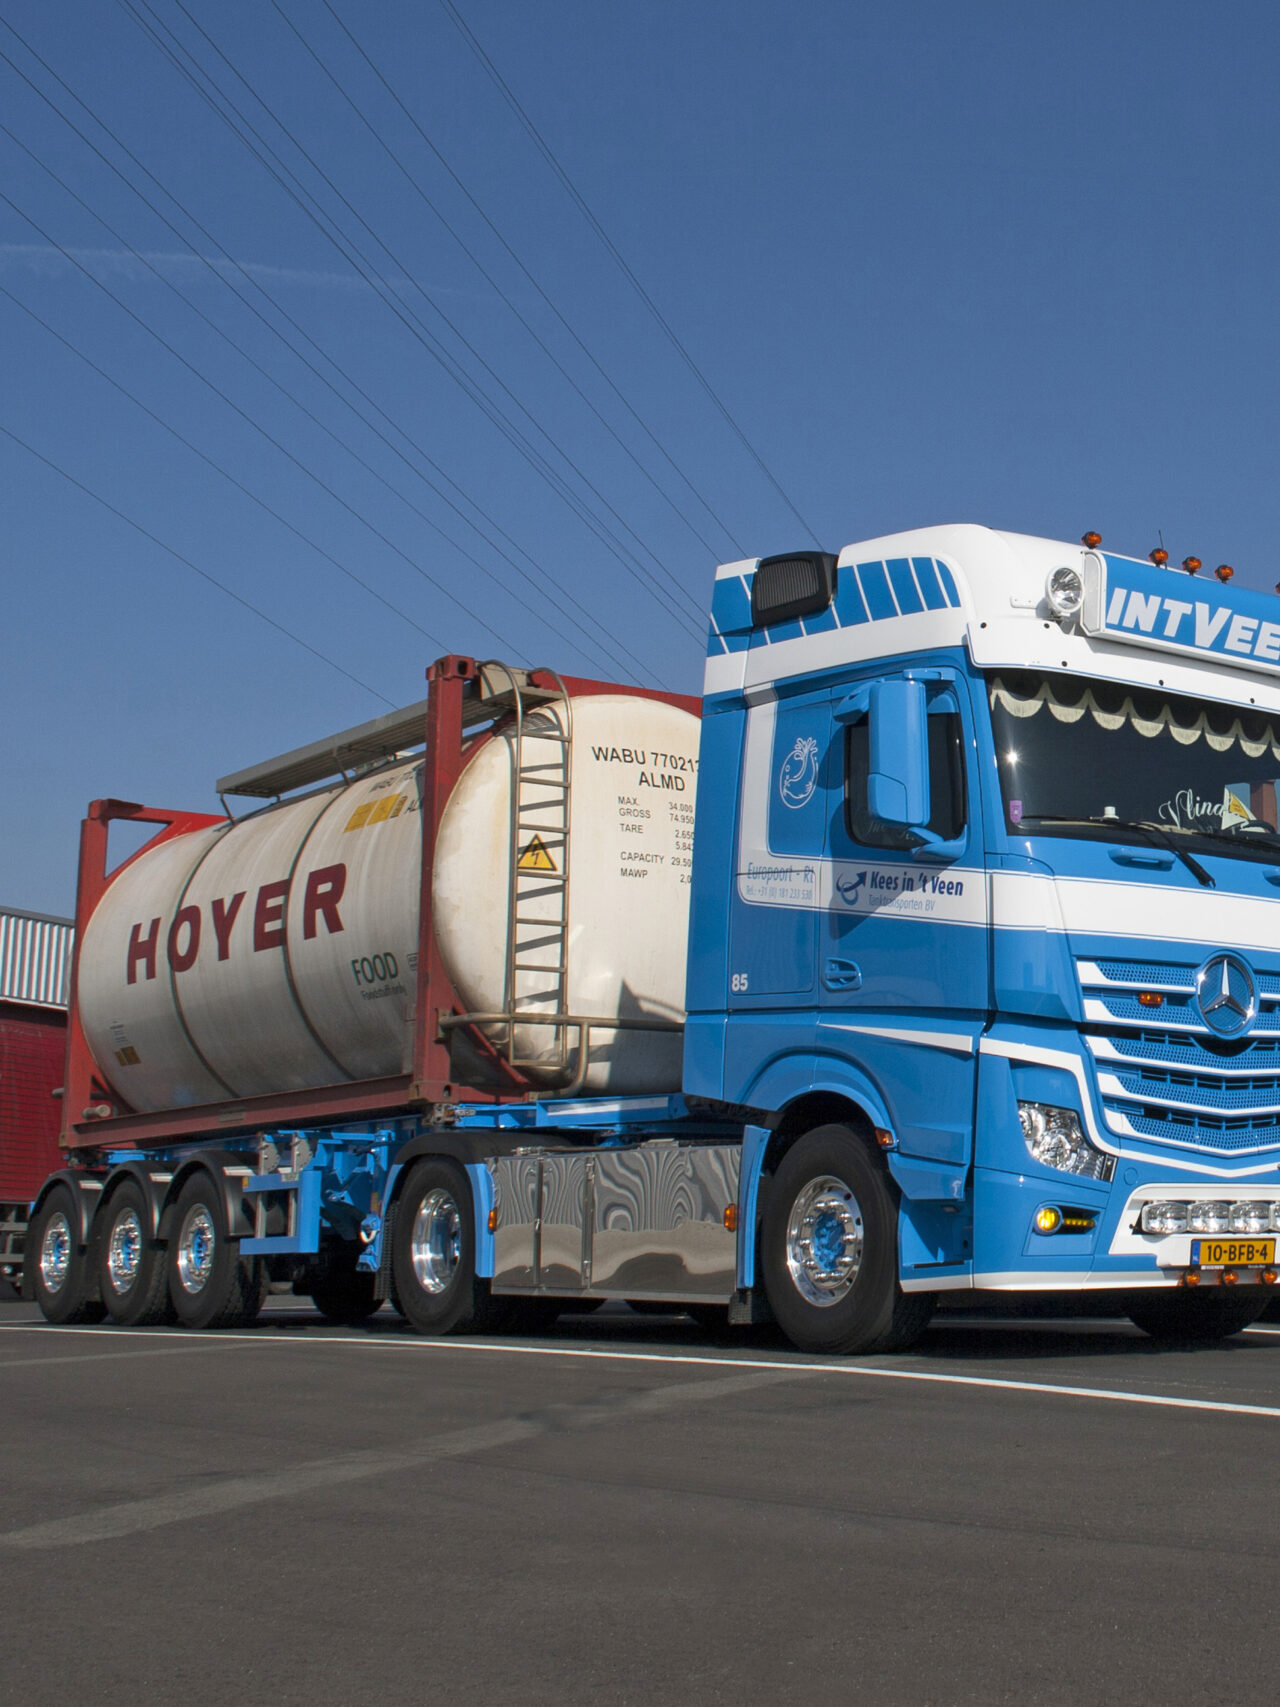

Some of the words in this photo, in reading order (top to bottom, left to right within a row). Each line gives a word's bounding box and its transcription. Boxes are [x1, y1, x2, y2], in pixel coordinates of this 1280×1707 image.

[591, 746, 646, 765] WABU
[639, 771, 686, 792] ALMD
[619, 807, 651, 819] GROSS
[668, 801, 693, 813] 34.000
[620, 823, 644, 834] TARE
[620, 851, 665, 864] CAPACITY
[620, 867, 648, 879] MAWP
[747, 862, 793, 885] Europoort
[870, 871, 899, 891] Kees
[901, 871, 914, 892] in
[918, 872, 929, 893] 't
[931, 875, 964, 896] Veen
[924, 899, 936, 911] BV
[127, 862, 347, 985] HOYER
[351, 952, 399, 985] FOOD
[731, 973, 748, 991] 85
[1207, 1244, 1268, 1262] 10-BFB-4
